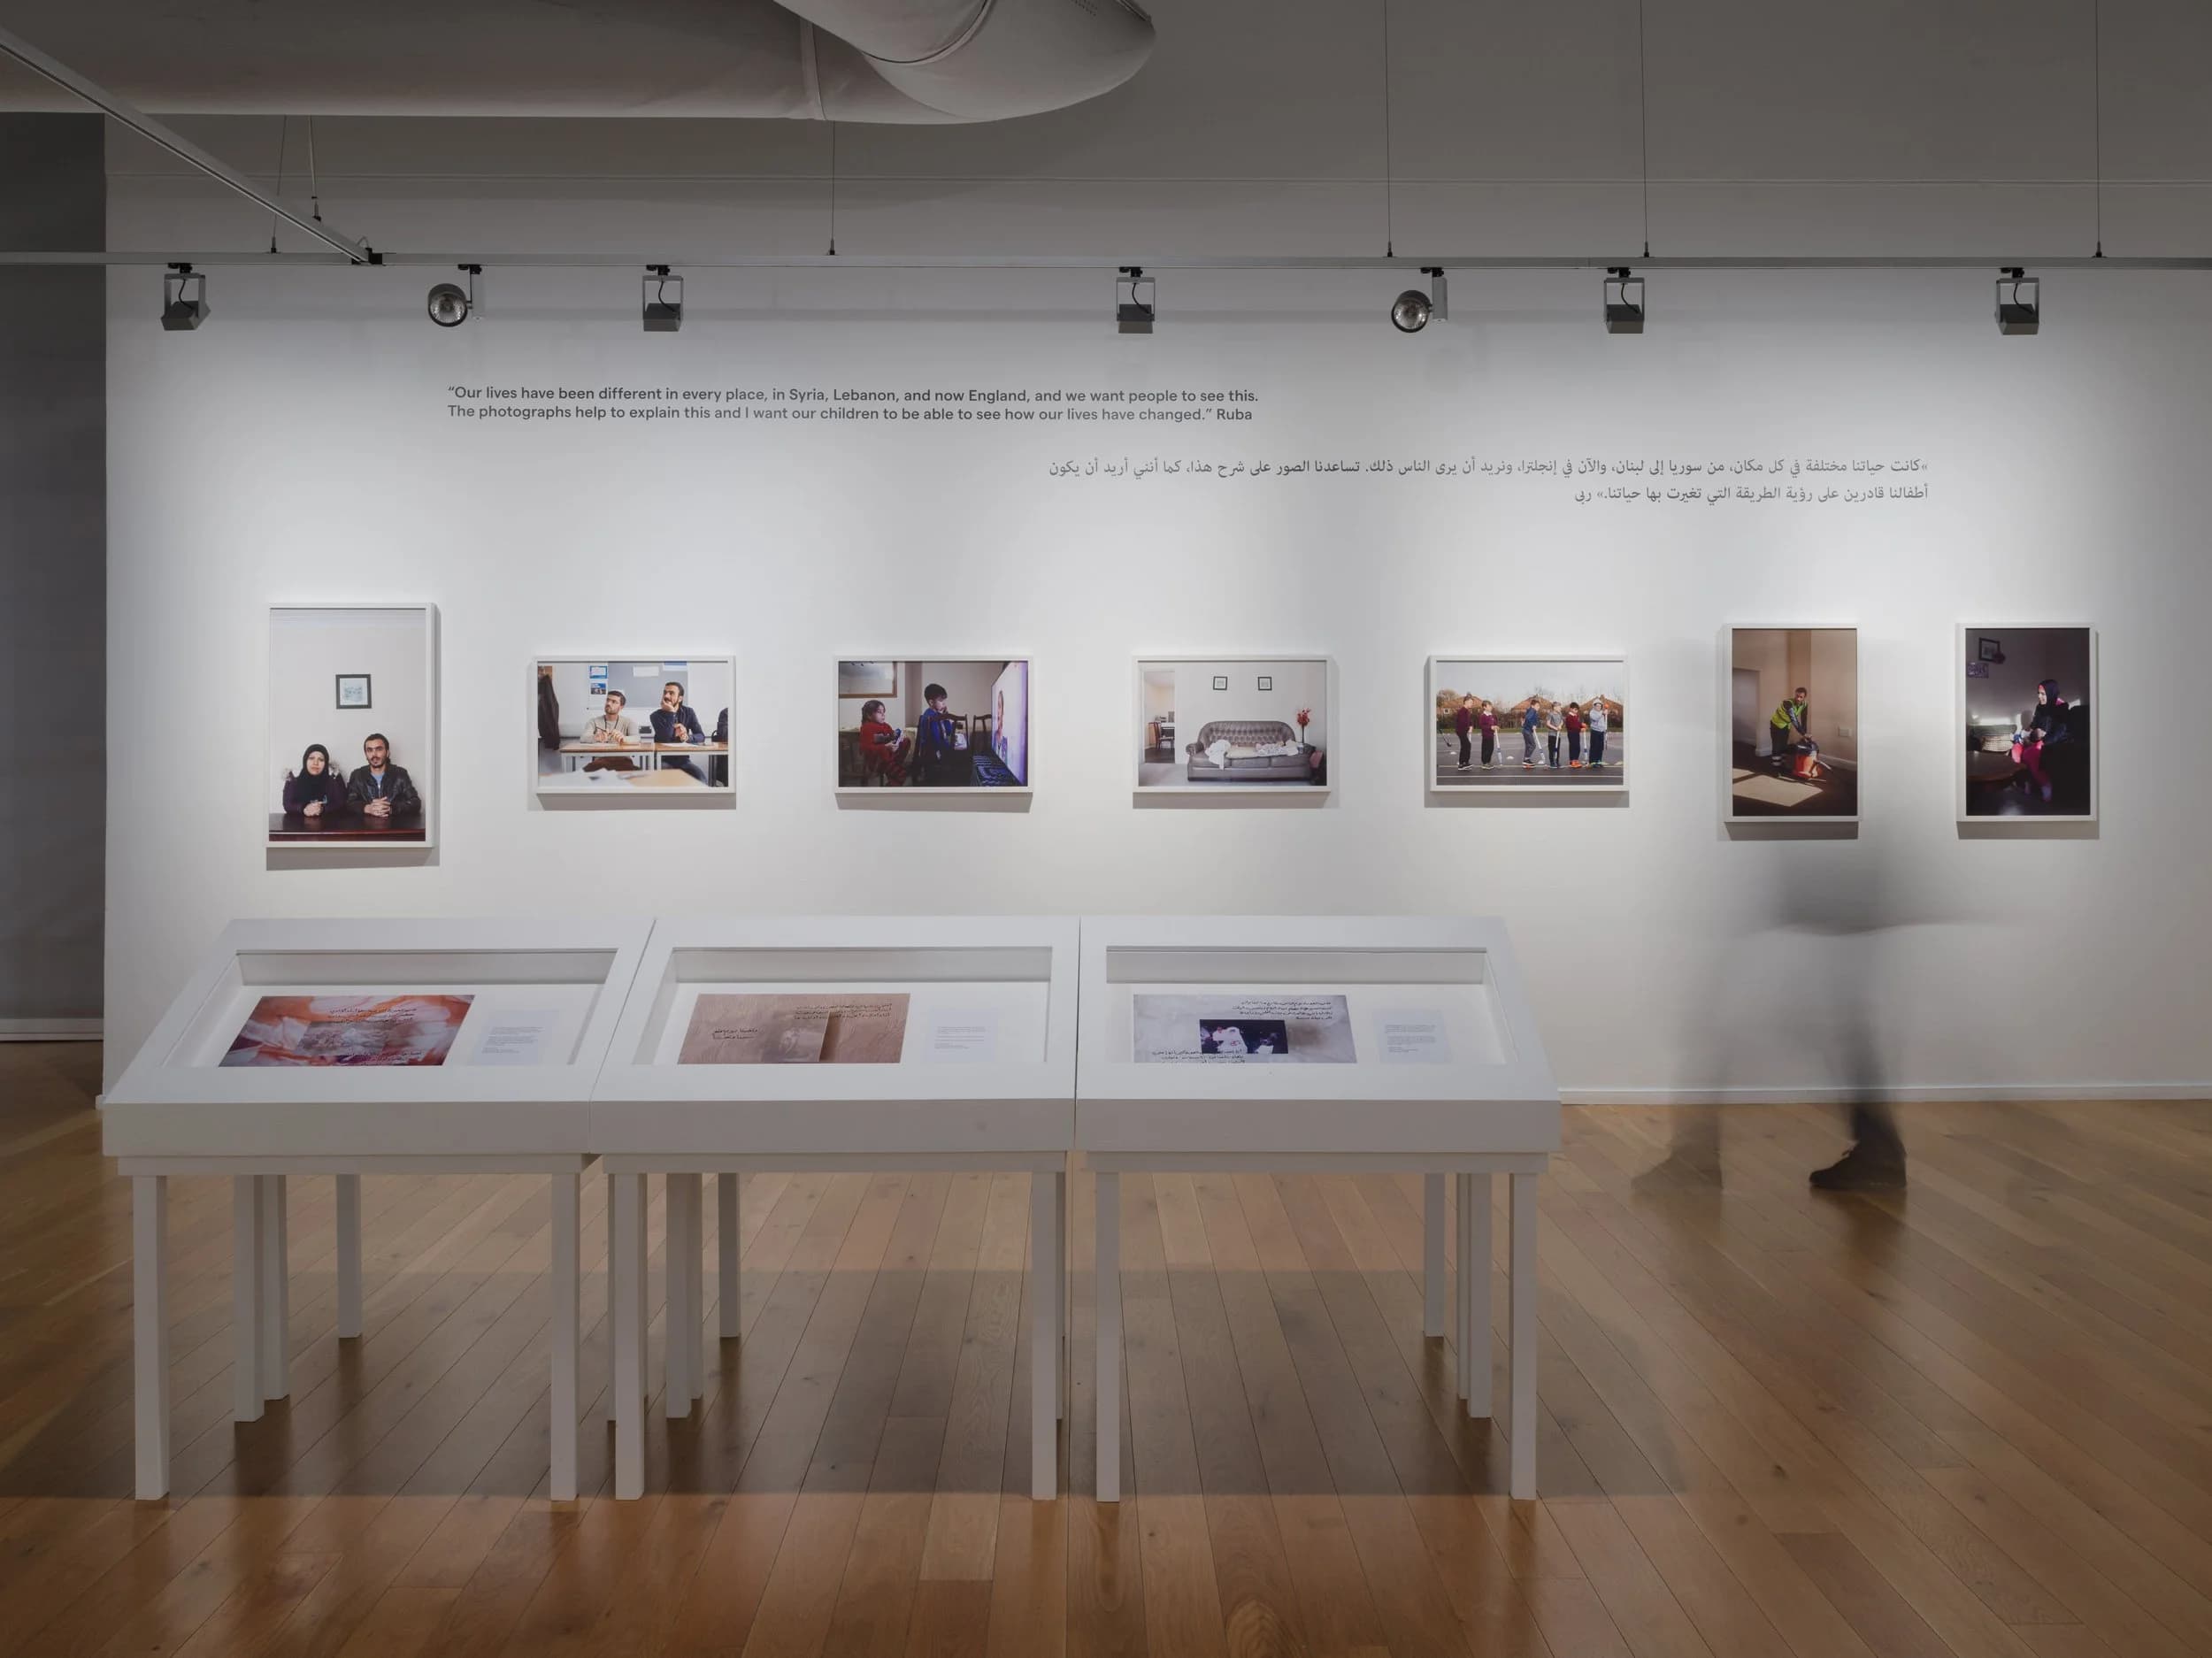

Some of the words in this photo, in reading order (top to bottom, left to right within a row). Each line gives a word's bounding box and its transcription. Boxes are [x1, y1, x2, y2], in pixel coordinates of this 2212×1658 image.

[487, 386, 517, 399] lives
[521, 387, 555, 399] have
[559, 387, 594, 399] been
[599, 387, 662, 399] different
[666, 388, 678, 400] in
[682, 390, 721, 403] every
[726, 388, 767, 403] place,
[772, 388, 785, 400] in
[789, 388, 828, 403] Syria,
[833, 389, 899, 403] Lebanon,
[904, 389, 930, 402] and
[935, 392, 964, 402] now
[969, 389, 1030, 404] England,
[1035, 389, 1061, 402] and
[1065, 393, 1086, 402] we
[1090, 390, 1125, 402] want
[1129, 389, 1178, 404] people
[1181, 390, 1196, 402] to
[1200, 393, 1225, 402] see
[1228, 389, 1258, 402] this.
[448, 405, 474, 417] The
[479, 405, 572, 420] photographs
[575, 406, 607, 421] help
[611, 407, 626, 418] to
[629, 406, 680, 422] explain
[684, 406, 710, 418] this
[715, 406, 741, 418] and
[753, 408, 788, 419] want
[792, 411, 817, 419] our
[820, 407, 879, 419] children
[883, 408, 897, 419] to
[902, 408, 921, 420] be
[924, 408, 955, 420] able
[957, 408, 972, 420] to
[977, 411, 1001, 420] see
[1005, 408, 1034, 420] how
[1039, 411, 1064, 420] our
[1067, 408, 1098, 420] lives
[1102, 408, 1134, 420] have
[1217, 408, 1252, 420] Ruba
[1049, 460, 1079, 477] يكون
[1085, 457, 1098, 476] أن
[1103, 457, 1128, 476] أريد
[1133, 457, 1157, 480] أنني
[1164, 459, 1181, 473] كما
[1217, 460, 1245, 478] شرح
[1249, 459, 1271, 476] على
[1276, 459, 1310, 476] الصور
[1313, 459, 1360, 472] تساعدنا
[1366, 459, 1394, 472] ذلك.
[1398, 459, 1430, 475] الناس
[1435, 463, 1456, 476] يرى
[1463, 456, 1476, 475] أن
[1479, 459, 1513, 476] ونريد
[1561, 458, 1573, 479] في
[1578, 457, 1607, 474] والآن
[1649, 459, 1663, 476] إلى
[1669, 459, 1701, 476] سوريا
[1707, 461, 1725, 475] من
[1769, 458, 1785, 473] كل
[1790, 459, 1801, 479] في
[1806, 458, 1847, 472] مختلفة
[1853, 459, 1885, 476] حياتنا
[1646, 487, 1662, 503] بها
[1667, 487, 1702, 503] تغيرت
[1707, 486, 1731, 506] التي
[1736, 486, 1780, 503] الطريقة
[1786, 486, 1812, 503] رؤية
[1817, 486, 1839, 503] على
[1844, 486, 1885, 503] قادرين
[1890, 482, 1928, 499] أطفالنا
